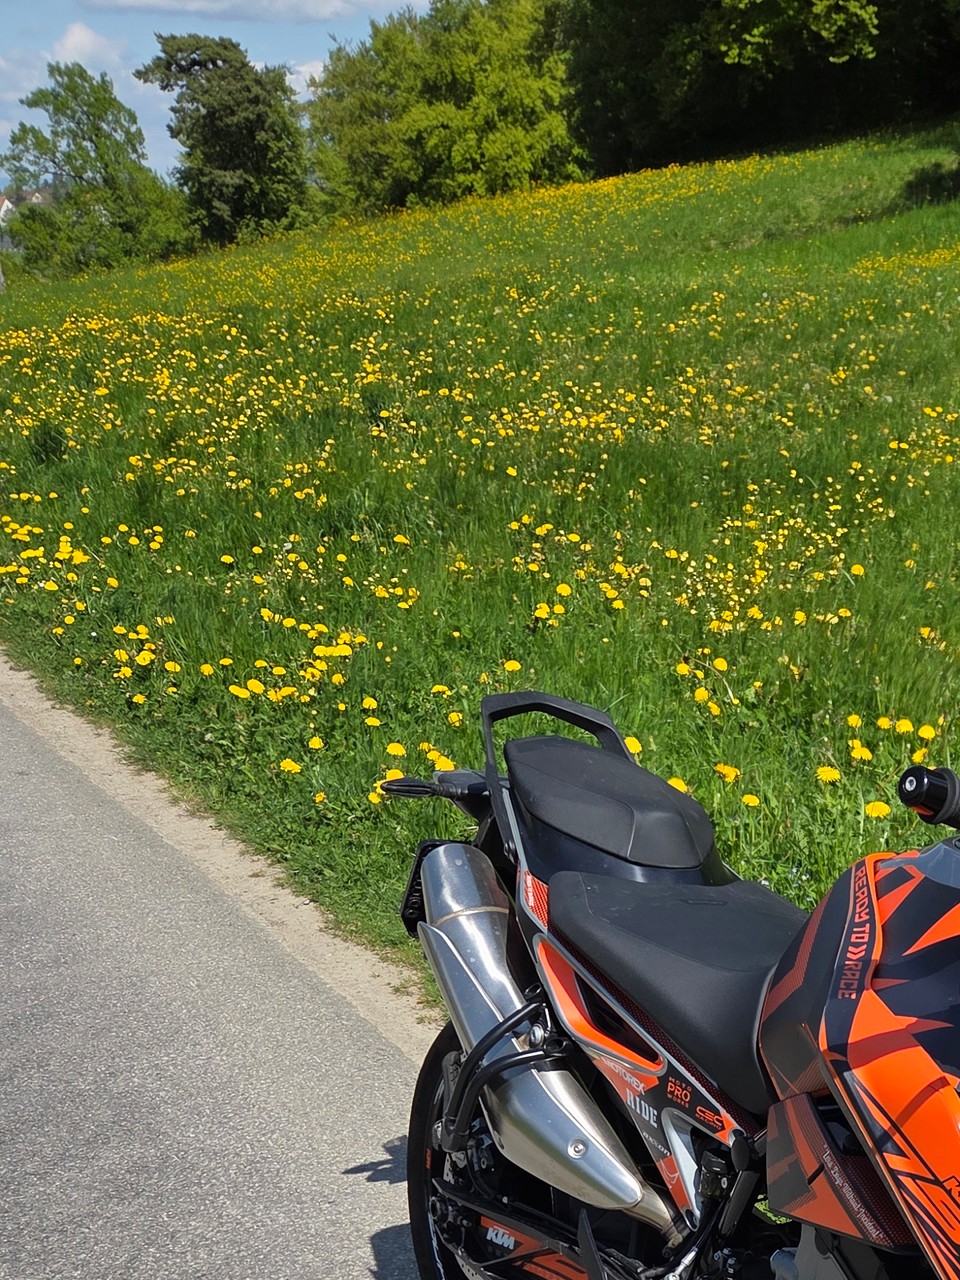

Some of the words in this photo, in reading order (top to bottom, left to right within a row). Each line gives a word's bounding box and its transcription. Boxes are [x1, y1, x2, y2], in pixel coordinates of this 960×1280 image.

[855, 866, 870, 923] READY
[852, 924, 869, 946] TO
[837, 960, 863, 1000] RACE
[601, 1056, 646, 1096] MOTOREX
[667, 1082, 691, 1102] PRO
[626, 1088, 658, 1129] RIDE
[486, 1226, 516, 1250] KTM
